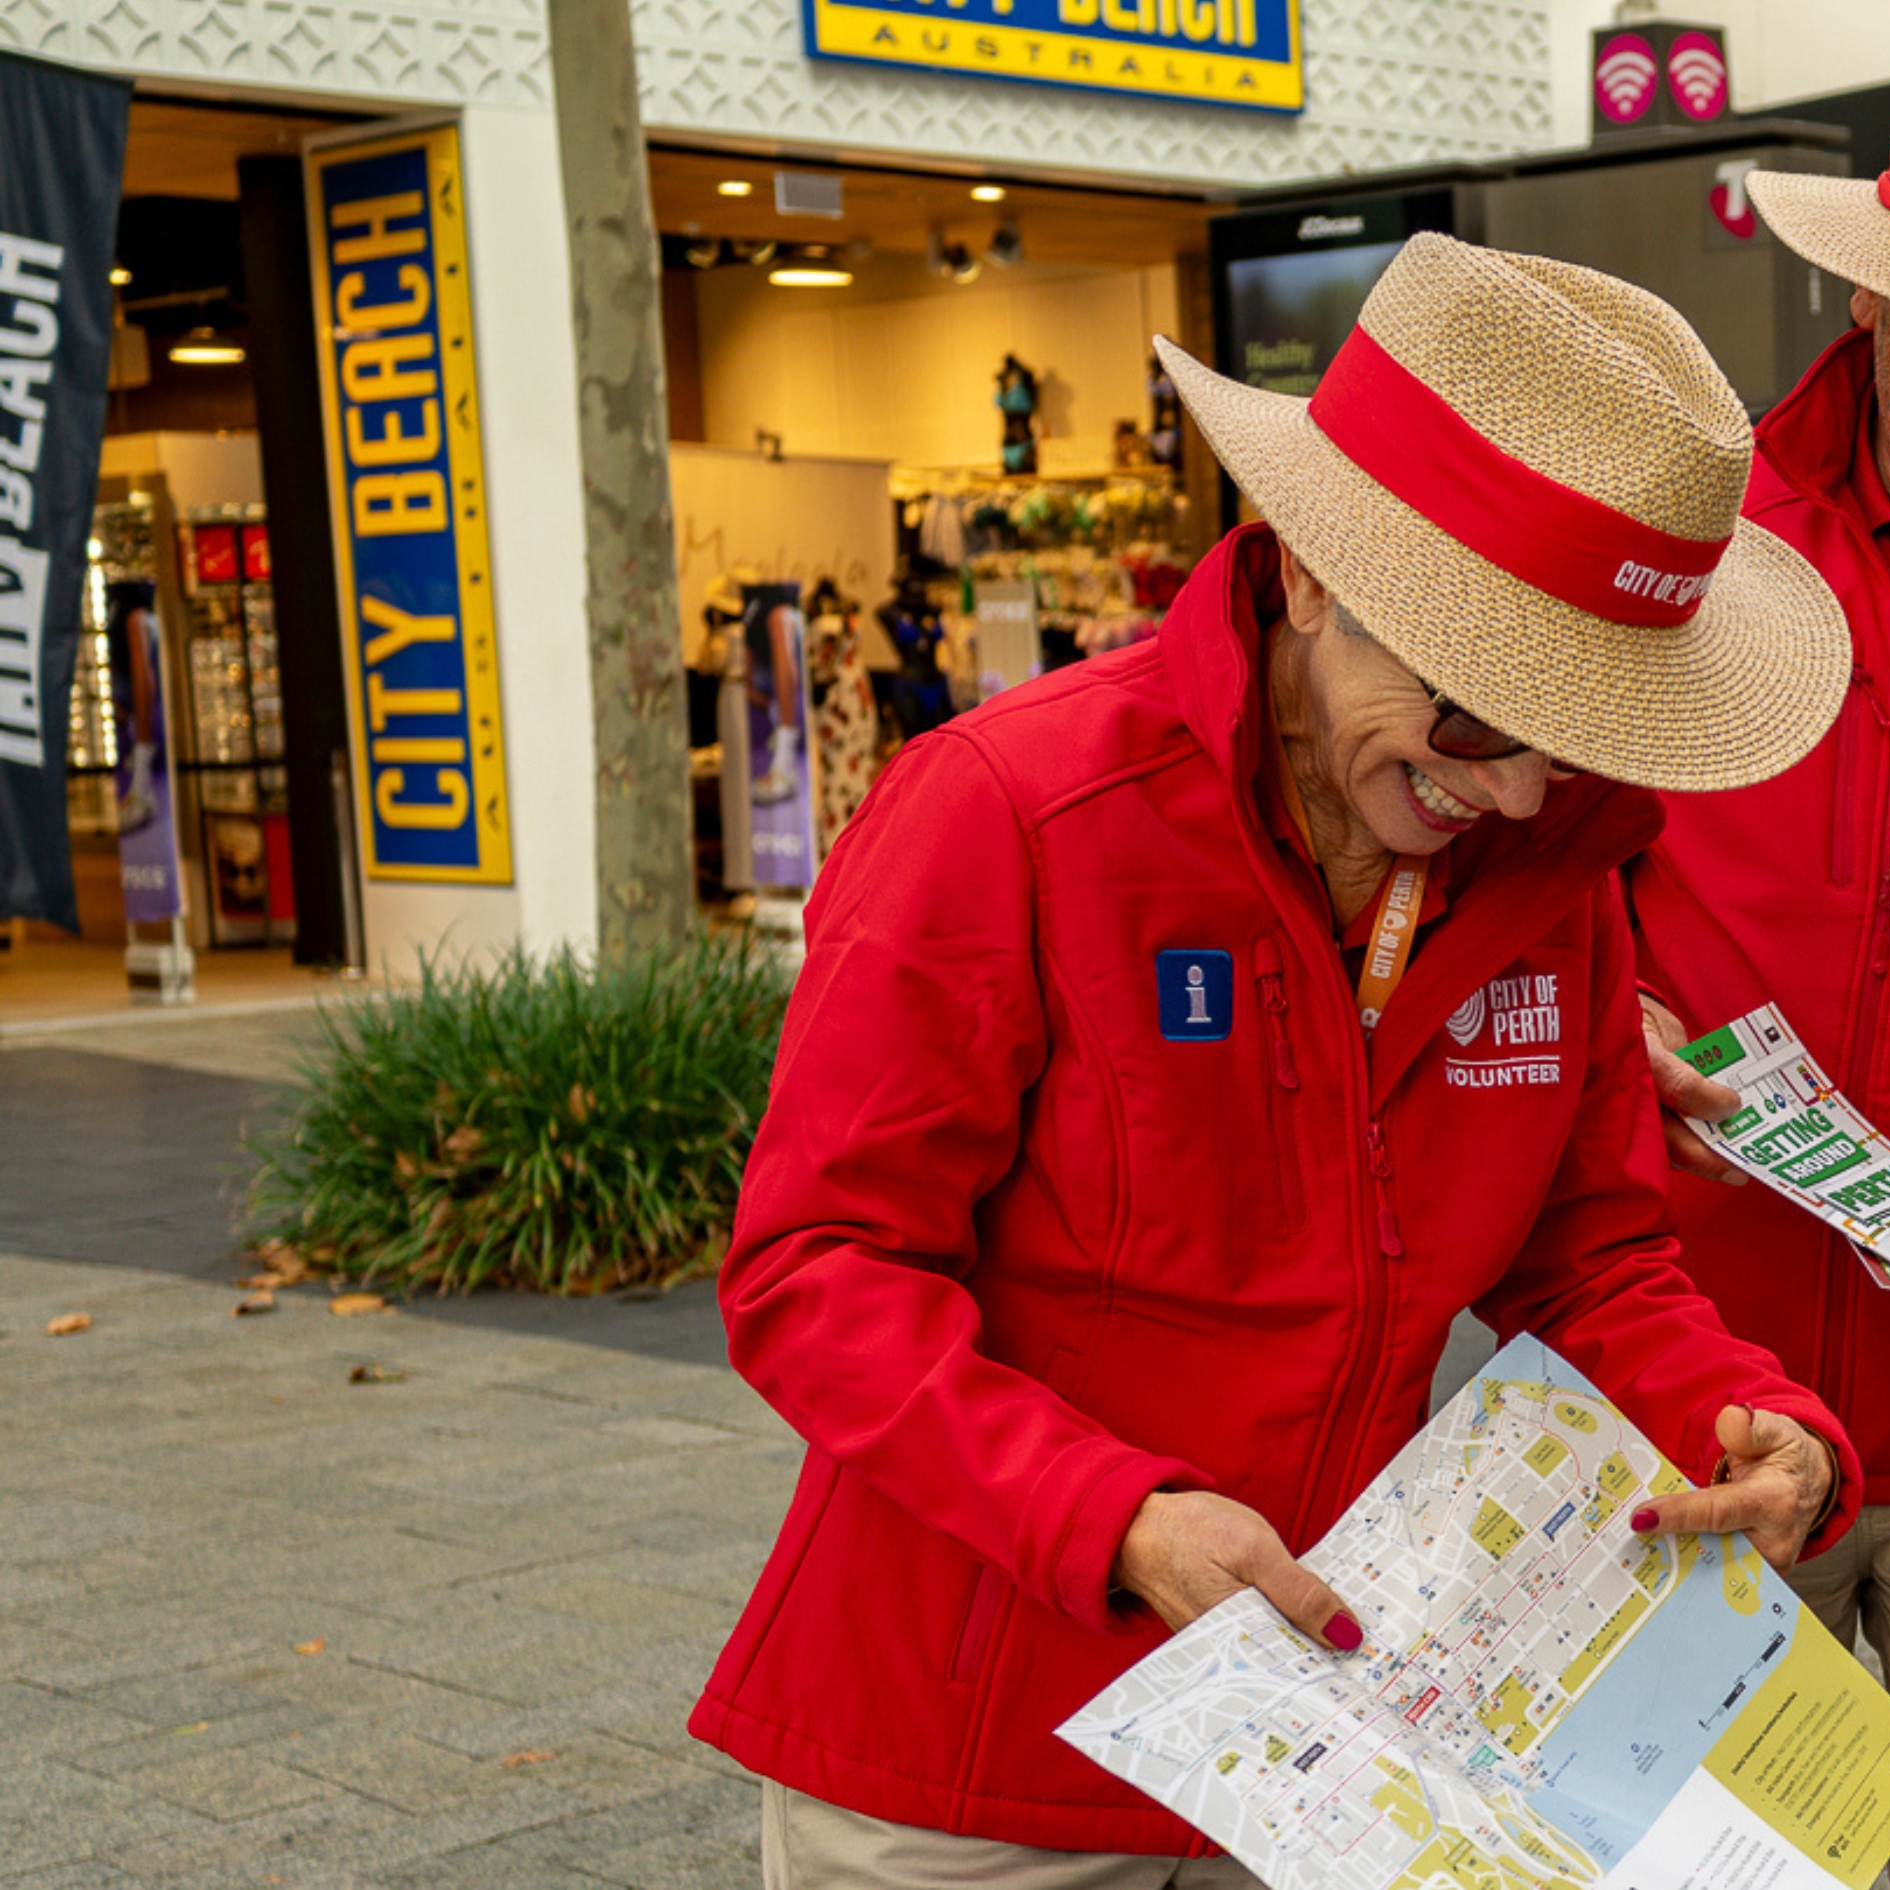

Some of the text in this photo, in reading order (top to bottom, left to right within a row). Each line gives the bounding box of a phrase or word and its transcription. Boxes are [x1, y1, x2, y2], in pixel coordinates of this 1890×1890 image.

[872, 25, 1259, 89] AUSTRALIA
[331, 190, 469, 830] CITY BEACH
[1614, 560, 1662, 596] CITY
[1654, 573, 1683, 603] OF
[1370, 870, 1415, 979] CITY OF PERTH
[1489, 975, 1557, 1009] CITY OF
[1493, 1006, 1560, 1046] PERTH
[1446, 1063, 1560, 1087] VOLUNTEER
[1741, 1107, 1834, 1165] GETTING
[1782, 1139, 1856, 1181] AROUND
